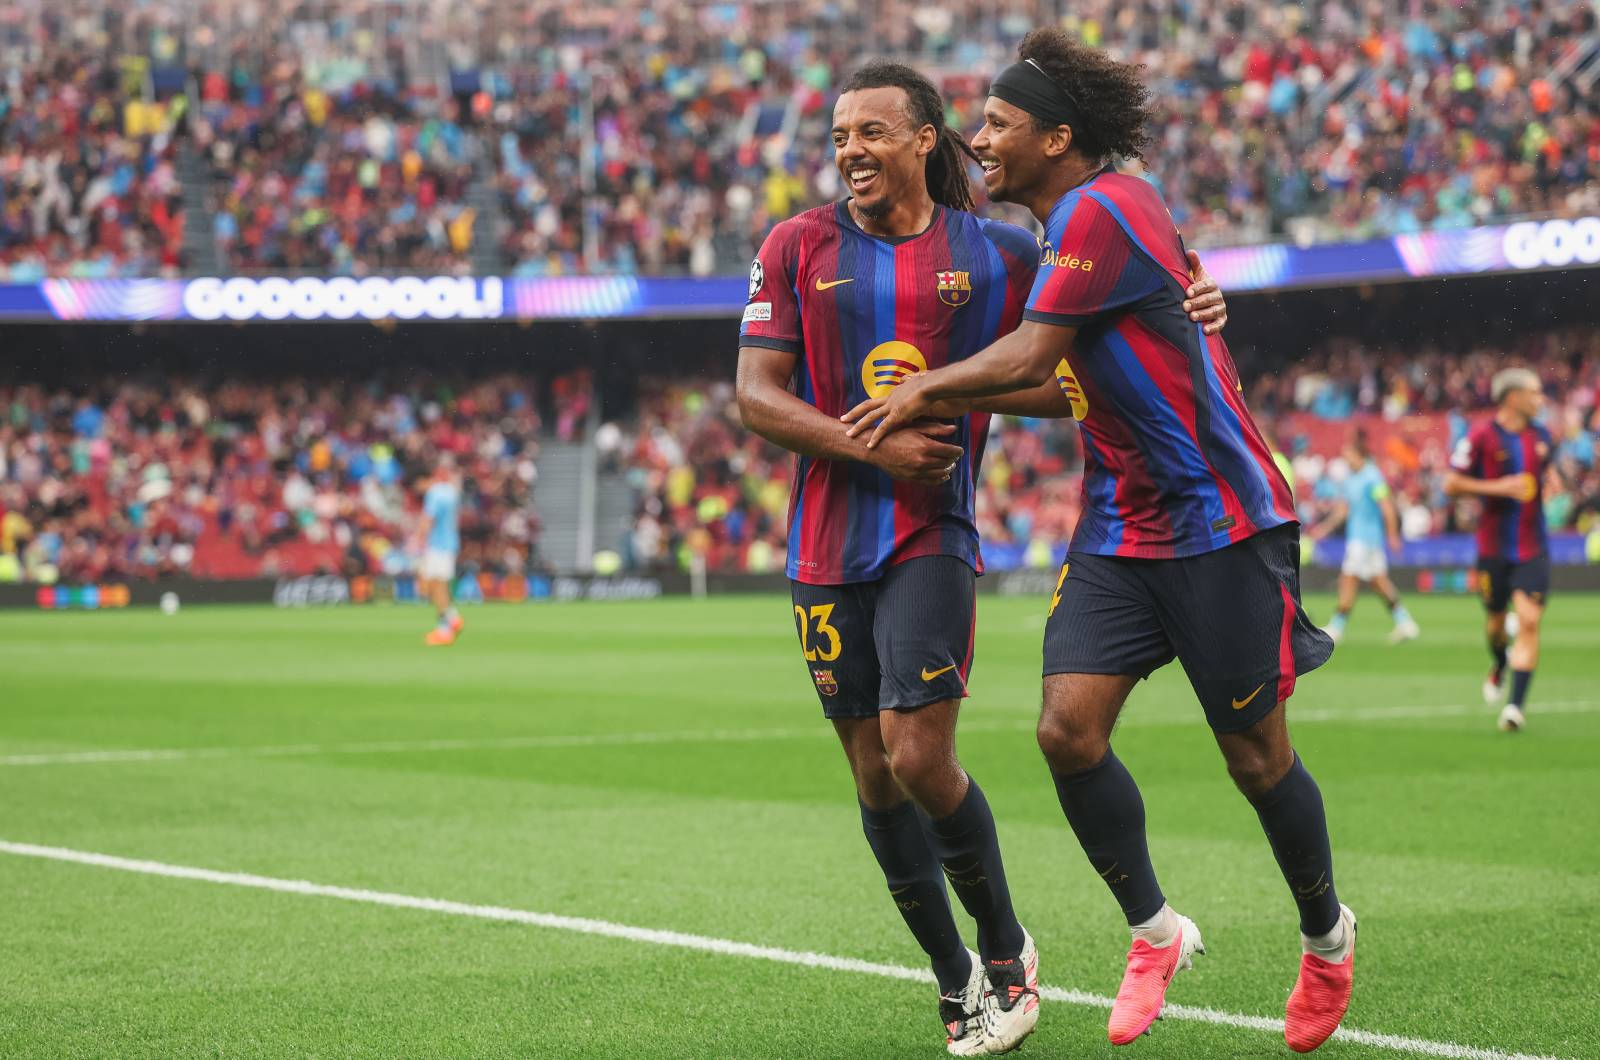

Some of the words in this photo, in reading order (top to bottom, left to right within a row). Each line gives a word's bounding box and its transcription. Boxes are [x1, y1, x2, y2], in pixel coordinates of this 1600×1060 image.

[1040, 246, 1093, 271] Midea
[183, 275, 503, 320] GOOOOOOOL!
[794, 602, 842, 662] 23
